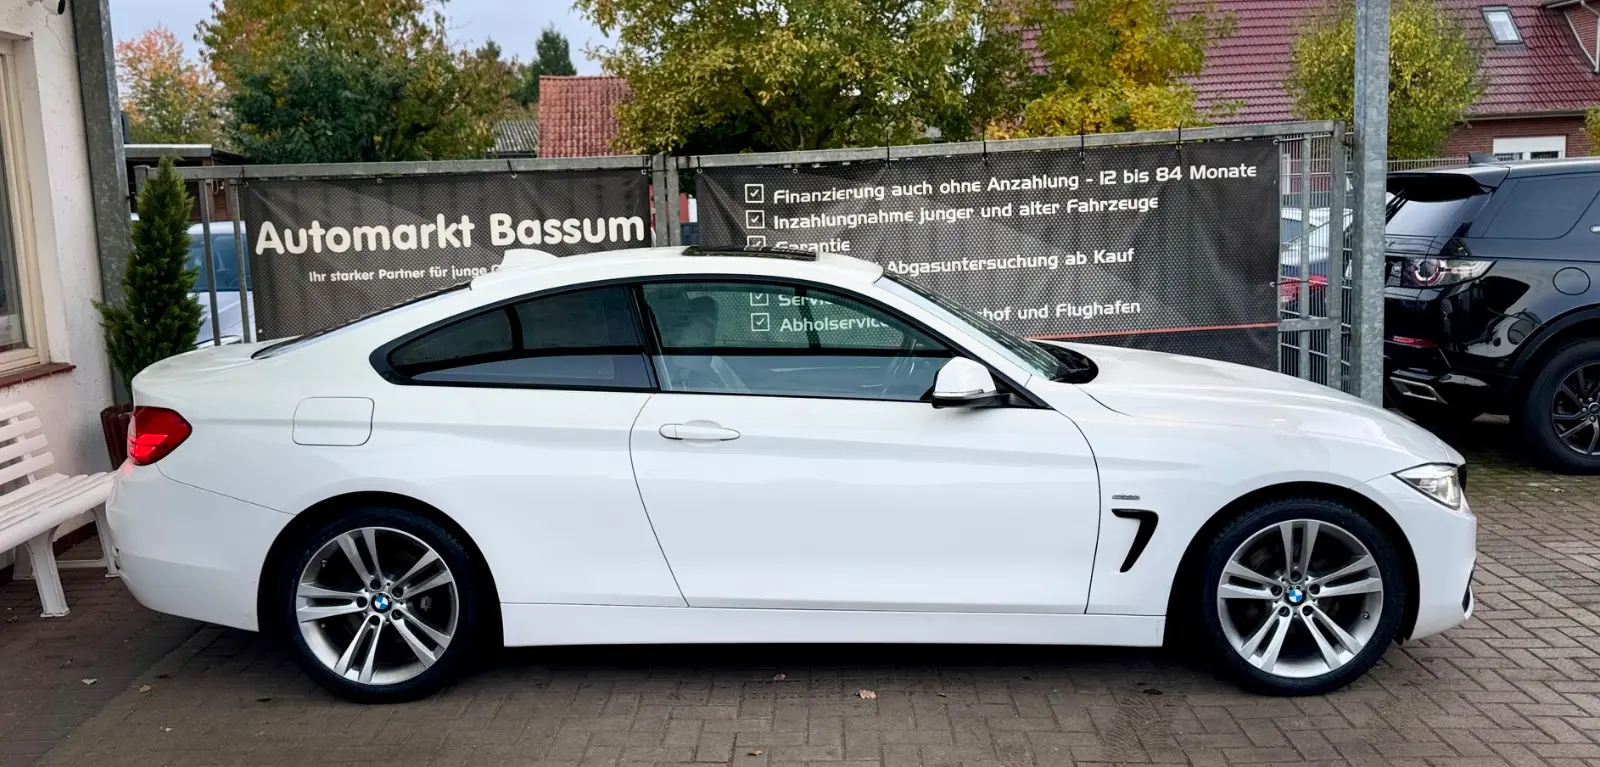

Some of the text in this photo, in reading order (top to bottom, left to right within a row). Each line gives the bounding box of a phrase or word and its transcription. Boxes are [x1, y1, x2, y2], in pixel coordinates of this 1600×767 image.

[773, 185, 885, 204] Finanzierung
[891, 180, 934, 196] auch
[939, 177, 982, 195] ohne
[987, 173, 1080, 193] Anzahlung
[1099, 170, 1118, 186] 12
[1123, 169, 1150, 184] bis
[1155, 166, 1183, 182] 84
[1189, 162, 1258, 181] Monate
[773, 196, 1160, 229] Inzahlungnahme junger und alter Fahrzeuge
[255, 212, 645, 255] Automarkt Bassum
[308, 270, 327, 283] Ihr
[330, 268, 374, 282] starker
[378, 267, 425, 280] Partner
[428, 265, 449, 278] für
[451, 265, 489, 279] junge
[887, 248, 1136, 277] Abgasuntersuchung ab Kauf
[977, 300, 1142, 321] hof und Flughafen
